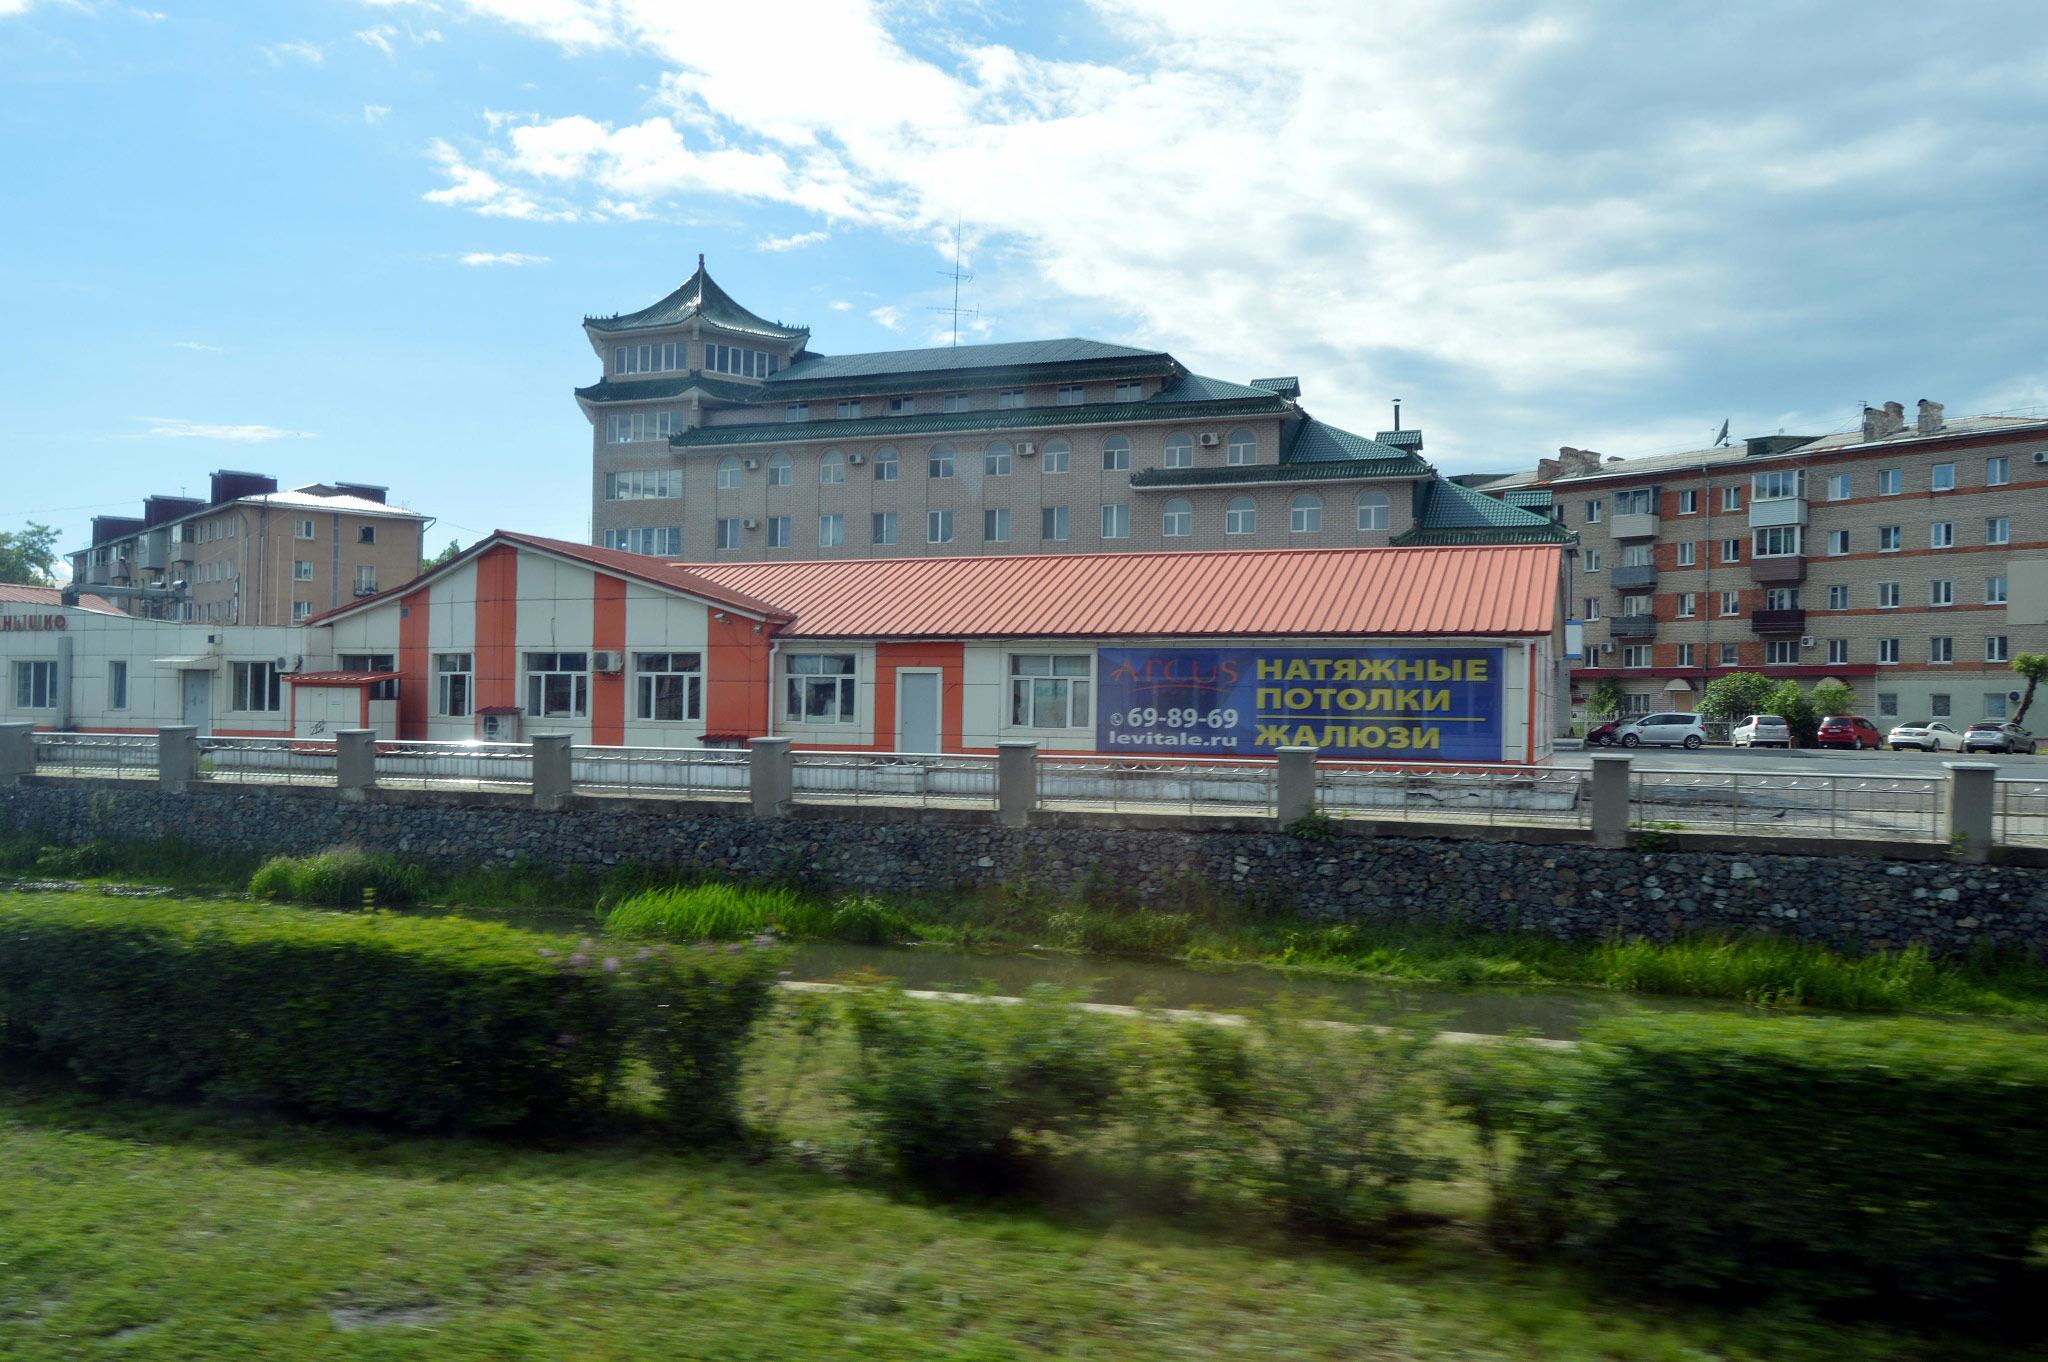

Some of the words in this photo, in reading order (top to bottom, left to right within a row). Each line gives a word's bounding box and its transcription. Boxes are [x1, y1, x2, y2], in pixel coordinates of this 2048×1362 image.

[1256, 658, 1488, 682] НАТЯЖНЫЕ
[1256, 687, 1451, 712] ПОТОЛКИ
[1127, 707, 1239, 729] 69-89-69
[1109, 730, 1238, 747] levitale.ru
[1254, 724, 1440, 750] ЖАЛЮЗИ
